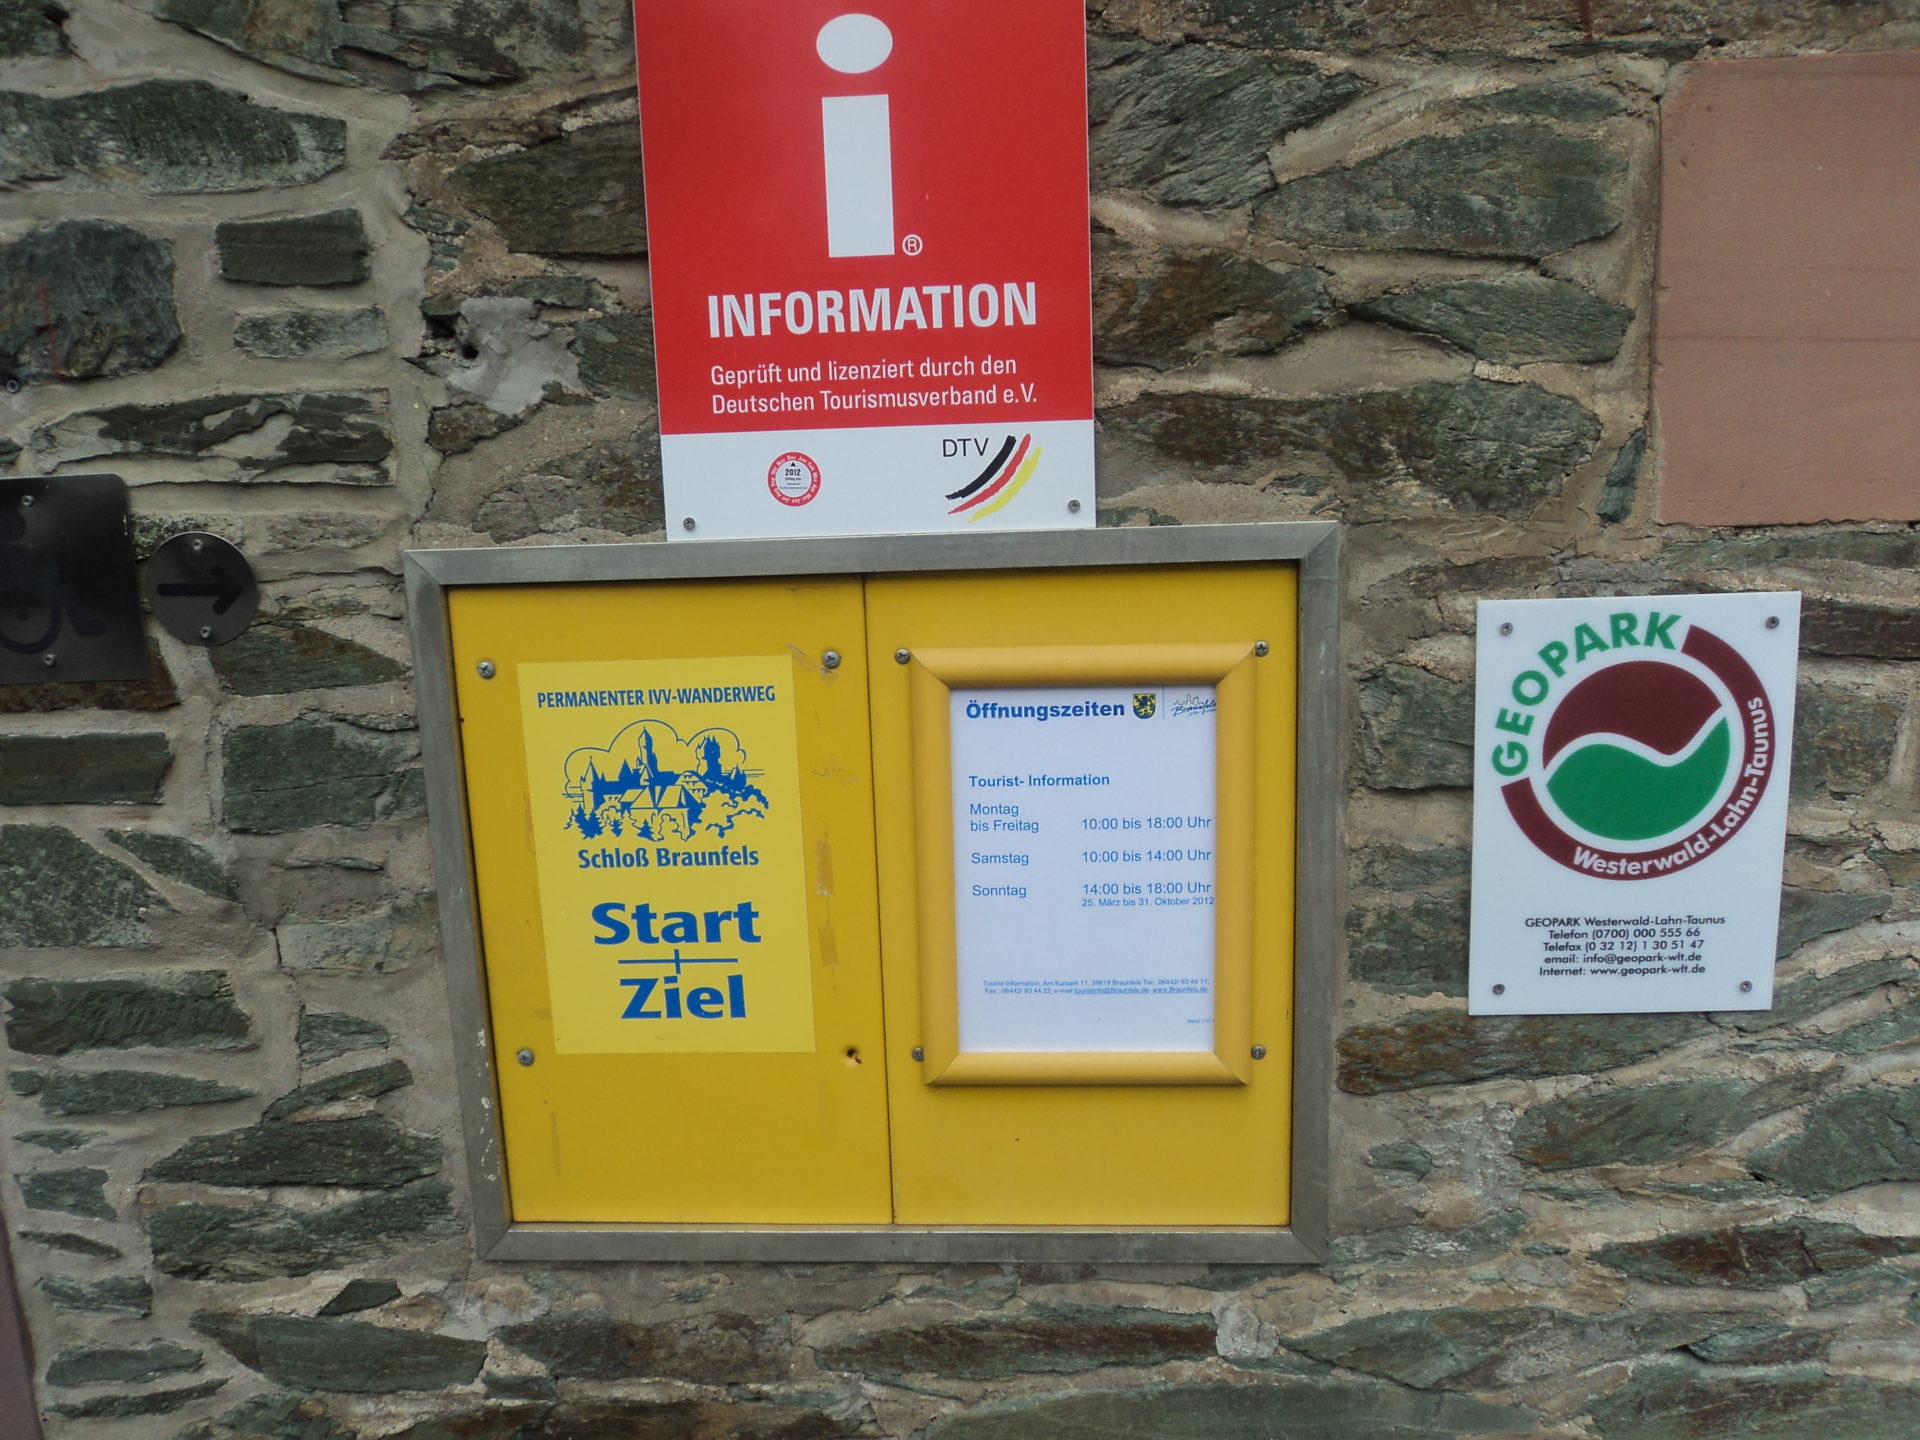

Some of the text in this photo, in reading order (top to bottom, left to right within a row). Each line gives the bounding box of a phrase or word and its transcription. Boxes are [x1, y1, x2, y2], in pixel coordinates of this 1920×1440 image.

[708, 282, 1037, 338] INFORMATION
[710, 354, 1017, 389] Geprüft und lizenziert durch den
[711, 390, 815, 415] Deutschen
[820, 383, 998, 411] Tourismusverband
[942, 437, 989, 458] DTV
[785, 468, 801, 476] 2012
[537, 685, 776, 708] PERMANENTER IVV-WANDERWEG
[1491, 611, 1682, 777] GEOPARK
[966, 699, 1125, 722] Öffnungszeiten
[969, 774, 1110, 788] Tourist- Information
[1572, 697, 1769, 876] Westerwald-Lahn-Taunus
[970, 803, 1019, 817] Montag
[970, 819, 1039, 834] bis Freitag
[1082, 817, 1212, 830] 10:00 bis 18:00 Uhr
[578, 845, 759, 869] Schloß Braunfels
[971, 852, 1029, 866] Samstag
[1082, 850, 1212, 863] 10:00 bis 14:00 Uhr
[972, 885, 1027, 899] Sonntag
[1082, 883, 1212, 896] 14:00 bis 18:00 Uhr
[1082, 897, 1215, 907] 25. März bis 31. Oktober 2012
[591, 901, 762, 945] Start
[1525, 915, 1726, 927] GEOPARK Westerwald-Lahn-Taunus
[1548, 927, 1701, 940] Telefon (0700) 000 555 66
[1543, 939, 1704, 953] Telefax (0 32 12) 1 30 51 47
[1544, 952, 1702, 965] email: info@geopark-wlt.de
[1539, 965, 1706, 977] Internet: www.geopark-wlt.de
[619, 974, 746, 1019] Ziel
